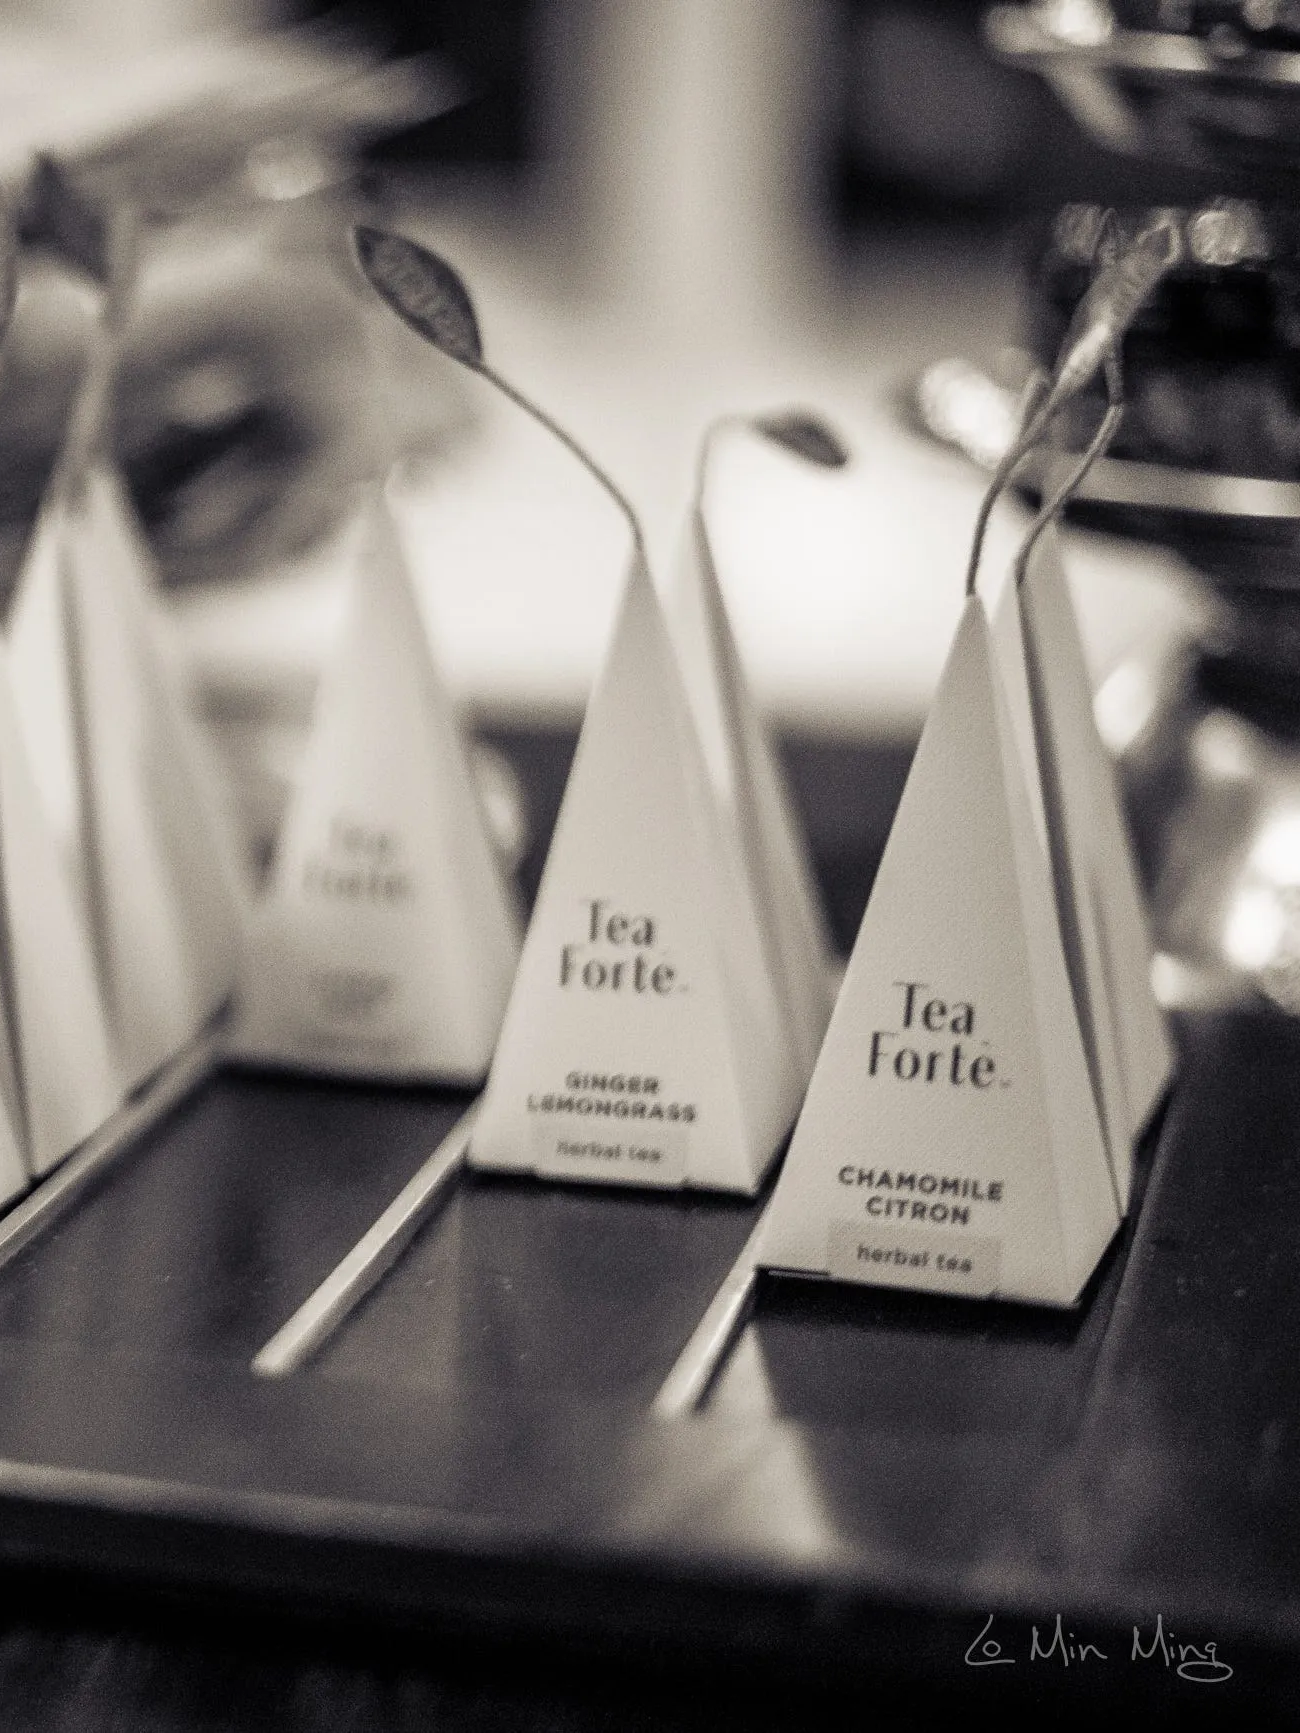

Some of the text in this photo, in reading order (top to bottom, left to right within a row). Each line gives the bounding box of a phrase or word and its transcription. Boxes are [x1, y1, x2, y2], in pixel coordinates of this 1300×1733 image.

[579, 900, 657, 947] Tea
[892, 981, 975, 1036] Tea
[565, 1071, 660, 1095] GINGER
[527, 1093, 697, 1123] LEMONGRASS
[556, 1139, 663, 1164] herbal tea
[837, 1165, 1004, 1203] CHAMOMILE
[865, 1195, 971, 1226] CITRON
[856, 1243, 973, 1274] herbal tea
